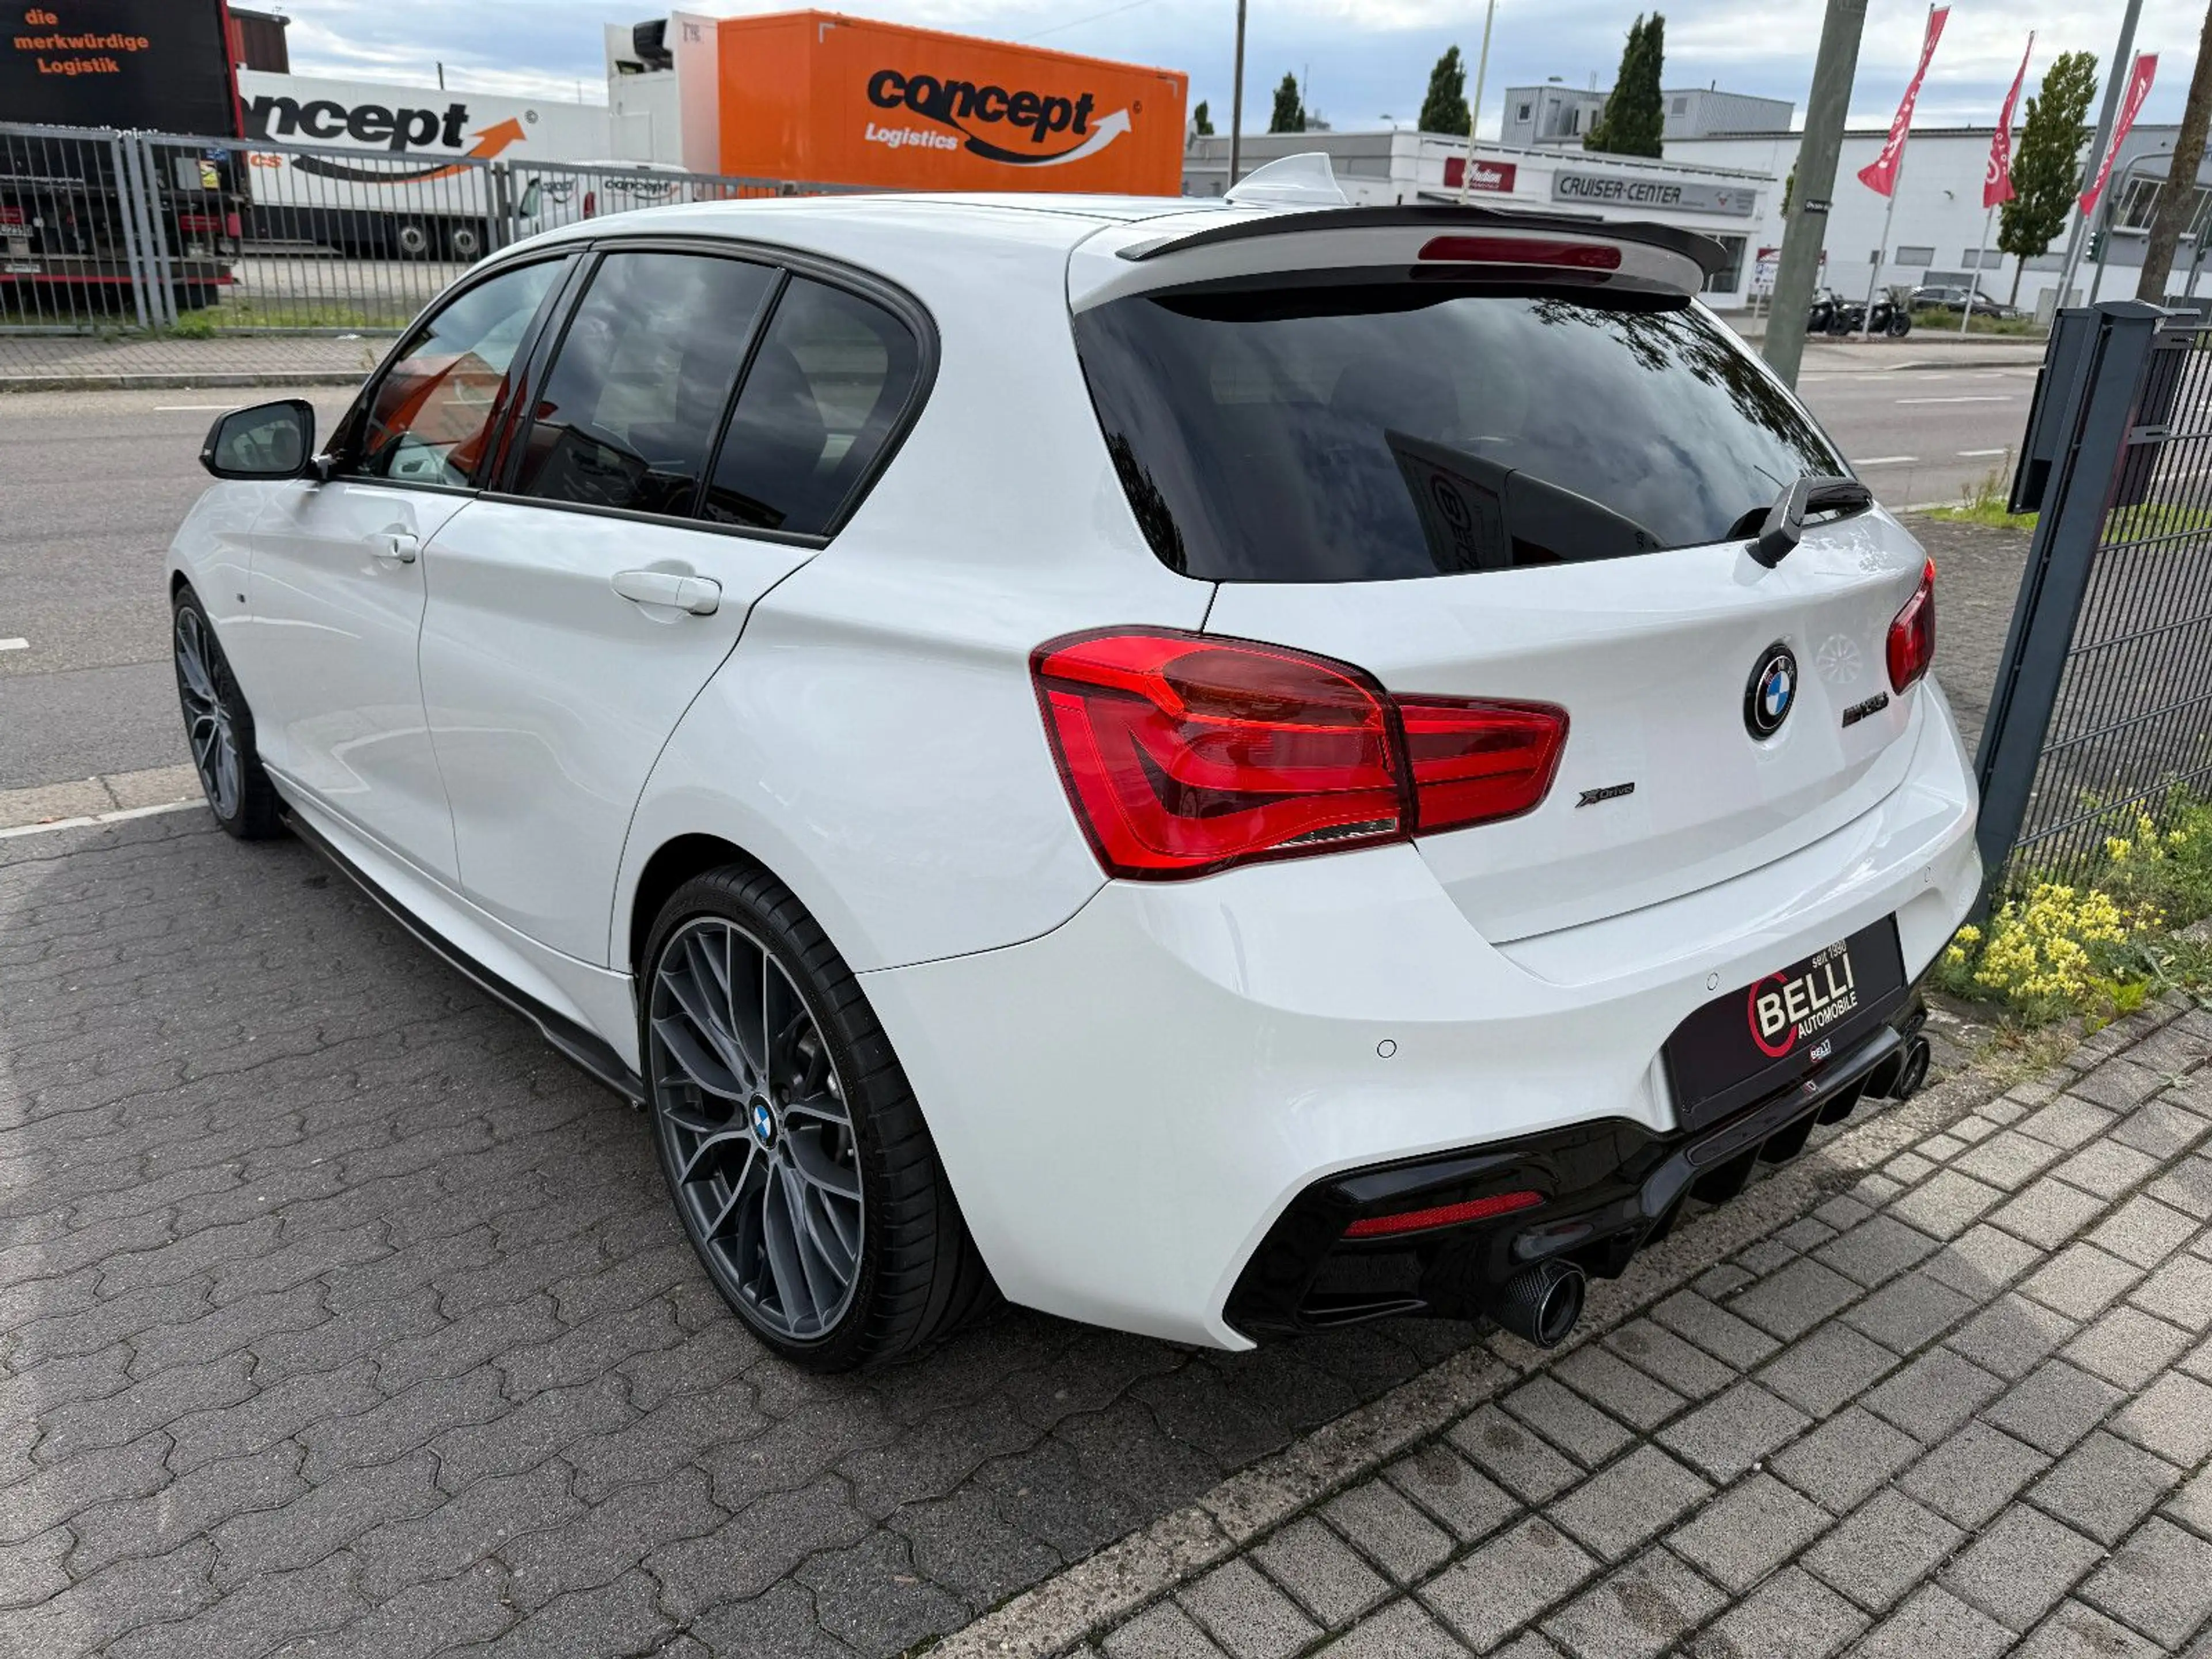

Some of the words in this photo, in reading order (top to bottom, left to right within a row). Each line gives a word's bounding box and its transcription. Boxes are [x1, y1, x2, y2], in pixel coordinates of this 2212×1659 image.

[25, 9, 58, 25] die
[14, 33, 149, 52] merkwürdige
[37, 58, 120, 75] Logistik
[868, 70, 1094, 143] concept
[238, 94, 469, 151] ncept
[865, 123, 959, 150] Logistics
[1560, 176, 1681, 203] CRUISER-CENTER
[1757, 953, 1854, 1038] BELLI
[1798, 991, 1858, 1039] AUTOMOBILE
